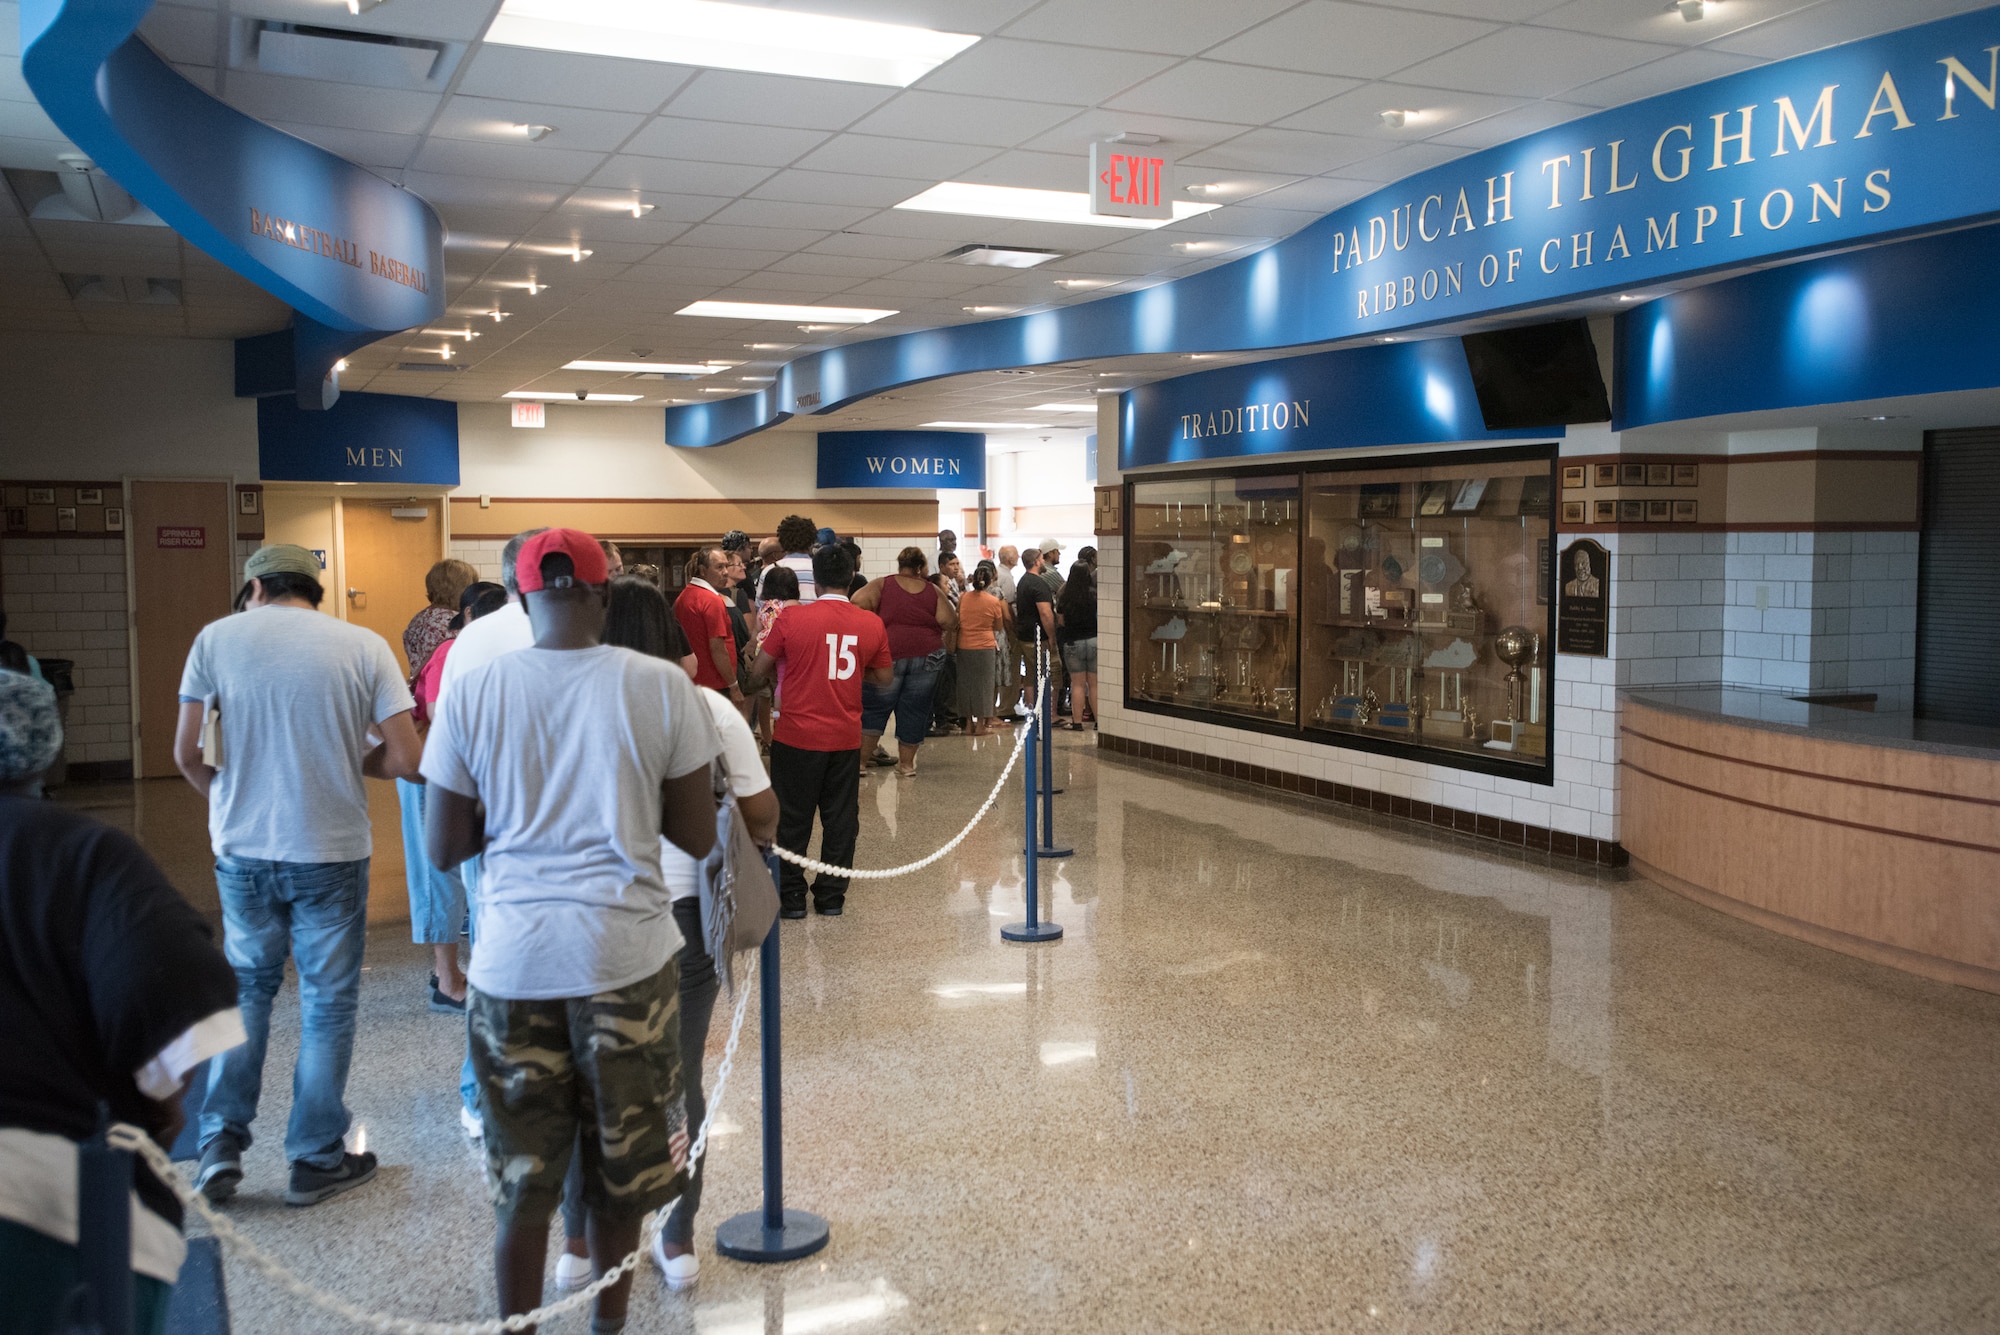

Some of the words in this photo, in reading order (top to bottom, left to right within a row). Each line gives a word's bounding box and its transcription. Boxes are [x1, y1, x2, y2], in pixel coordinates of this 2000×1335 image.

[1110, 153, 1164, 207] EXIT
[1332, 171, 1515, 274] PADUCAH
[1542, 46, 2000, 210] TILGHMAN
[250, 207, 363, 268] BASKETBALL
[369, 250, 428, 294] BASEBALL
[1357, 262, 1464, 319] RIBBON
[1479, 248, 1523, 288] OF
[1540, 168, 1891, 274] CHAMPIONS
[517, 404, 540, 423] EXIT
[1181, 400, 1310, 440] TRADITION
[345, 446, 403, 468] MEN
[866, 456, 961, 476] WOMEN
[160, 537, 181, 546] RISER
[182, 537, 204, 546] ROOM
[162, 529, 201, 538] SPRINKLER
[826, 633, 858, 680] 15
